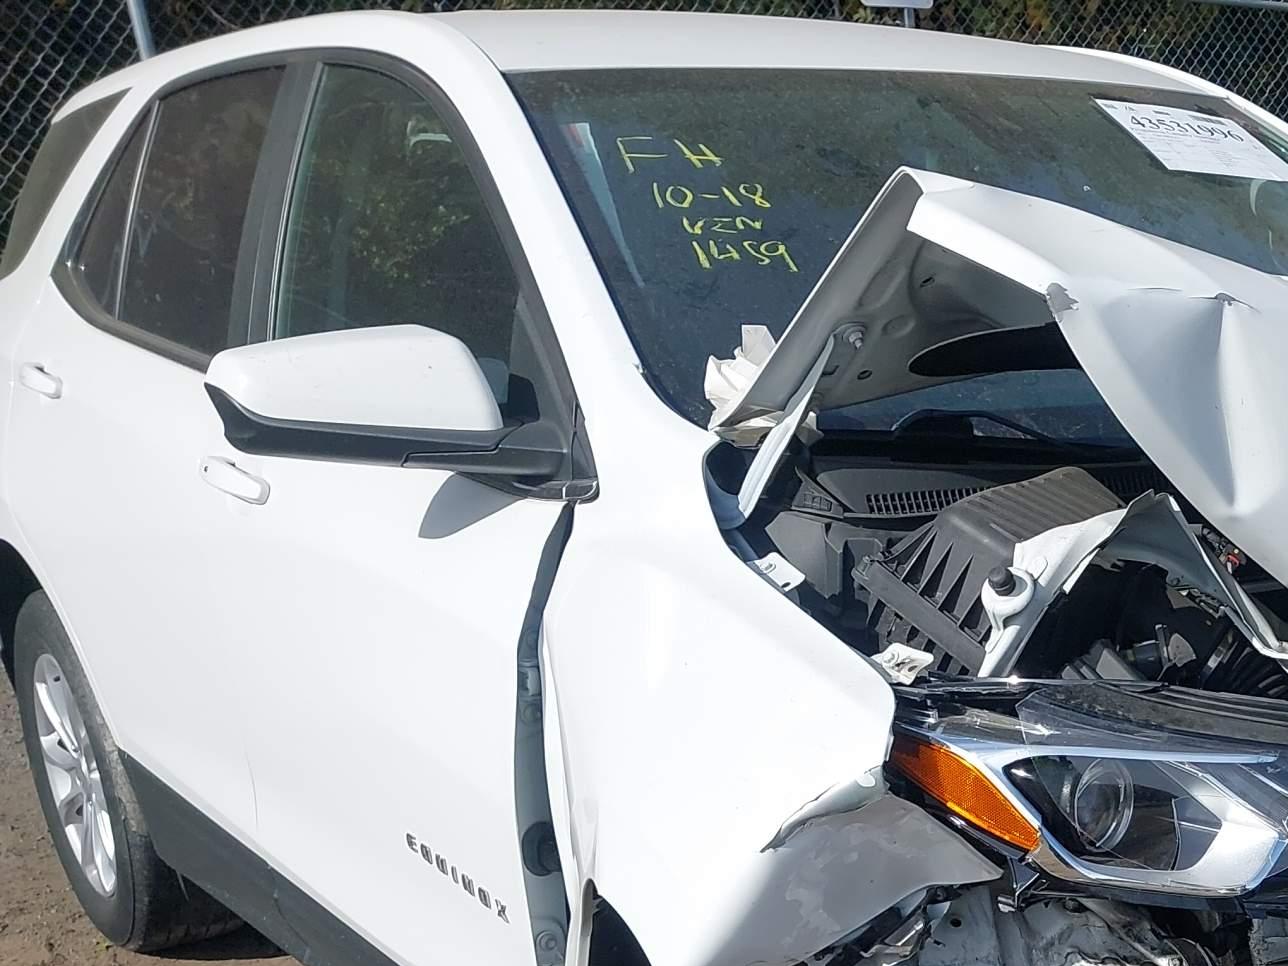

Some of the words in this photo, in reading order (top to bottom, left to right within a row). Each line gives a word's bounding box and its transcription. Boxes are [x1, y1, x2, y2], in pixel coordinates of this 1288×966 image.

[1130, 115, 1244, 142] 43531996
[652, 182, 772, 208] 10-18
[692, 239, 799, 273] 1459
